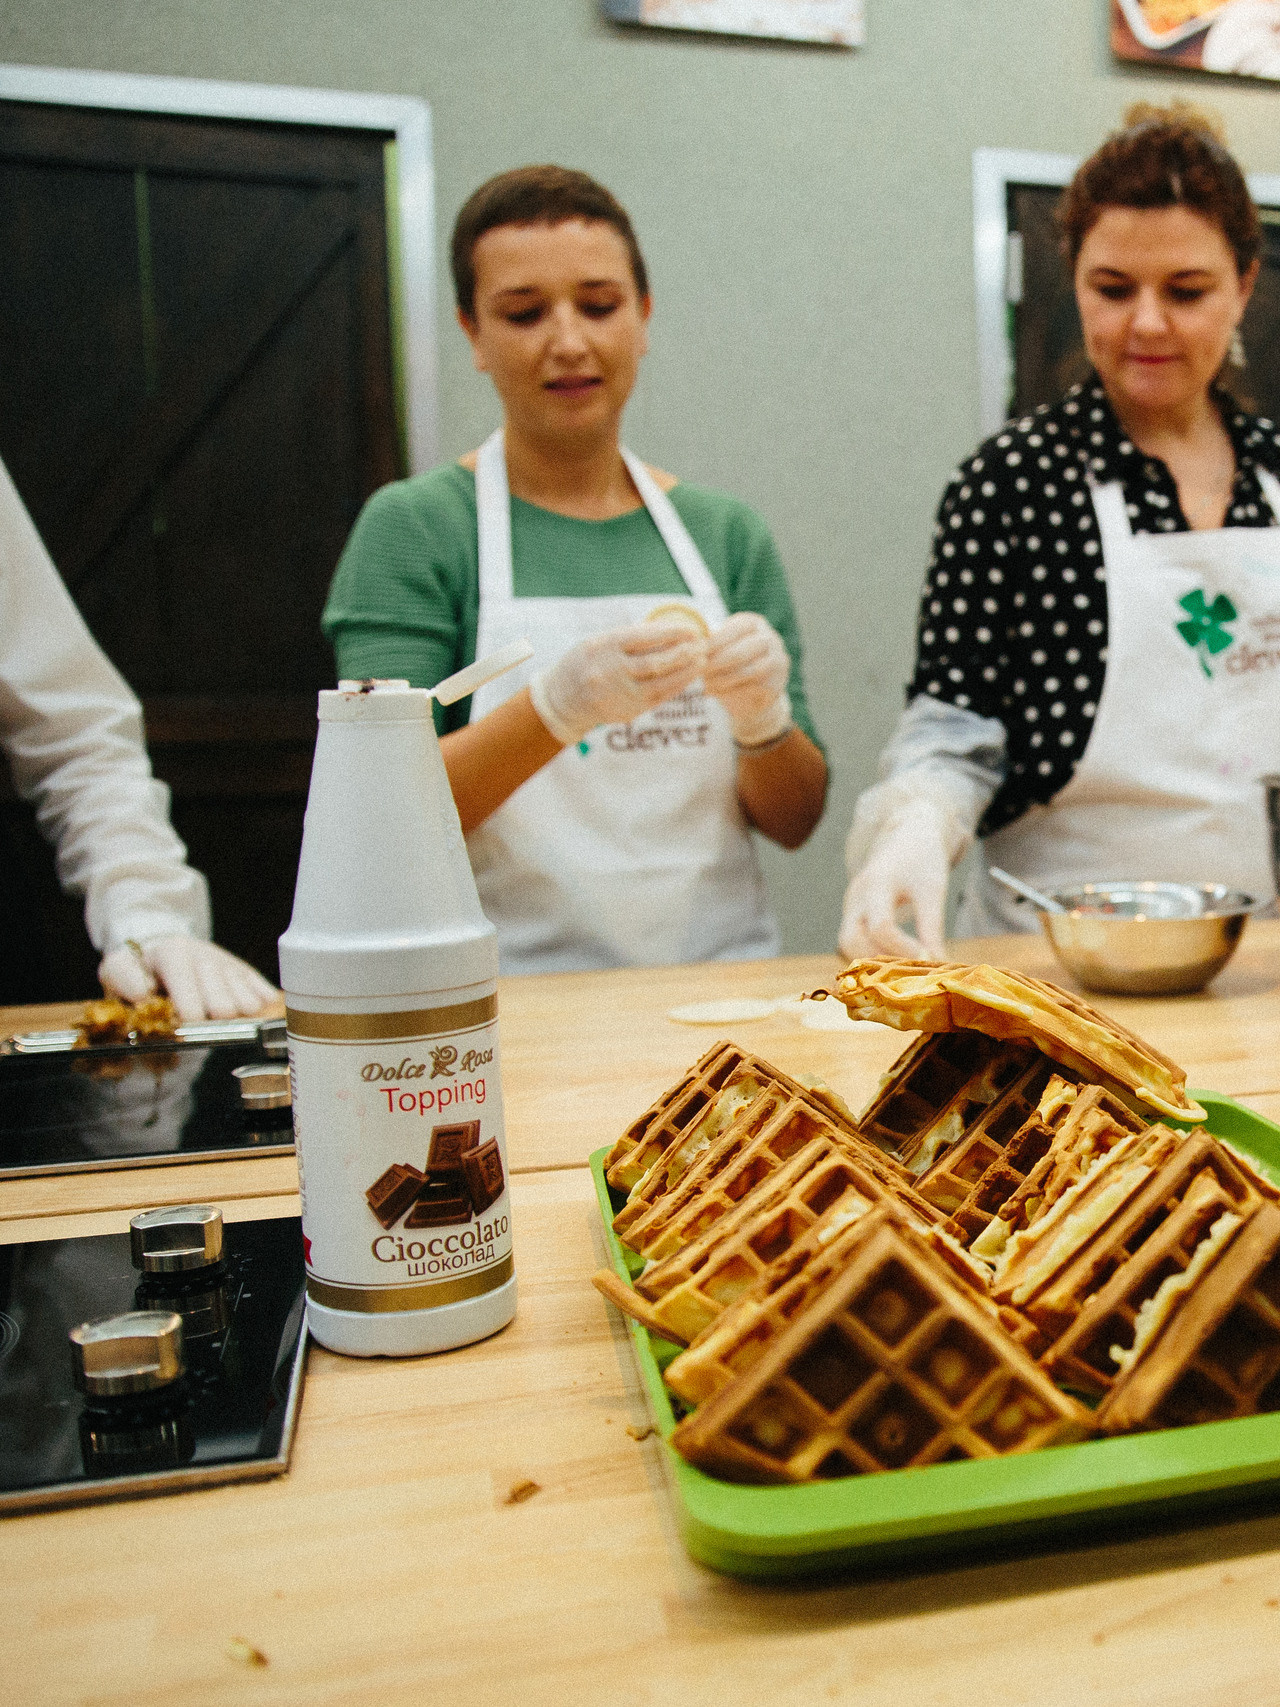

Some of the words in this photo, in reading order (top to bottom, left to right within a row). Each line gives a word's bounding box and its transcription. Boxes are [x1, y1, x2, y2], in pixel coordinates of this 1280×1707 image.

[361, 1057, 427, 1082] Dolce
[379, 1078, 486, 1116] Topping
[371, 1215, 509, 1263] Cioccolato
[407, 1243, 496, 1277] шоколад
